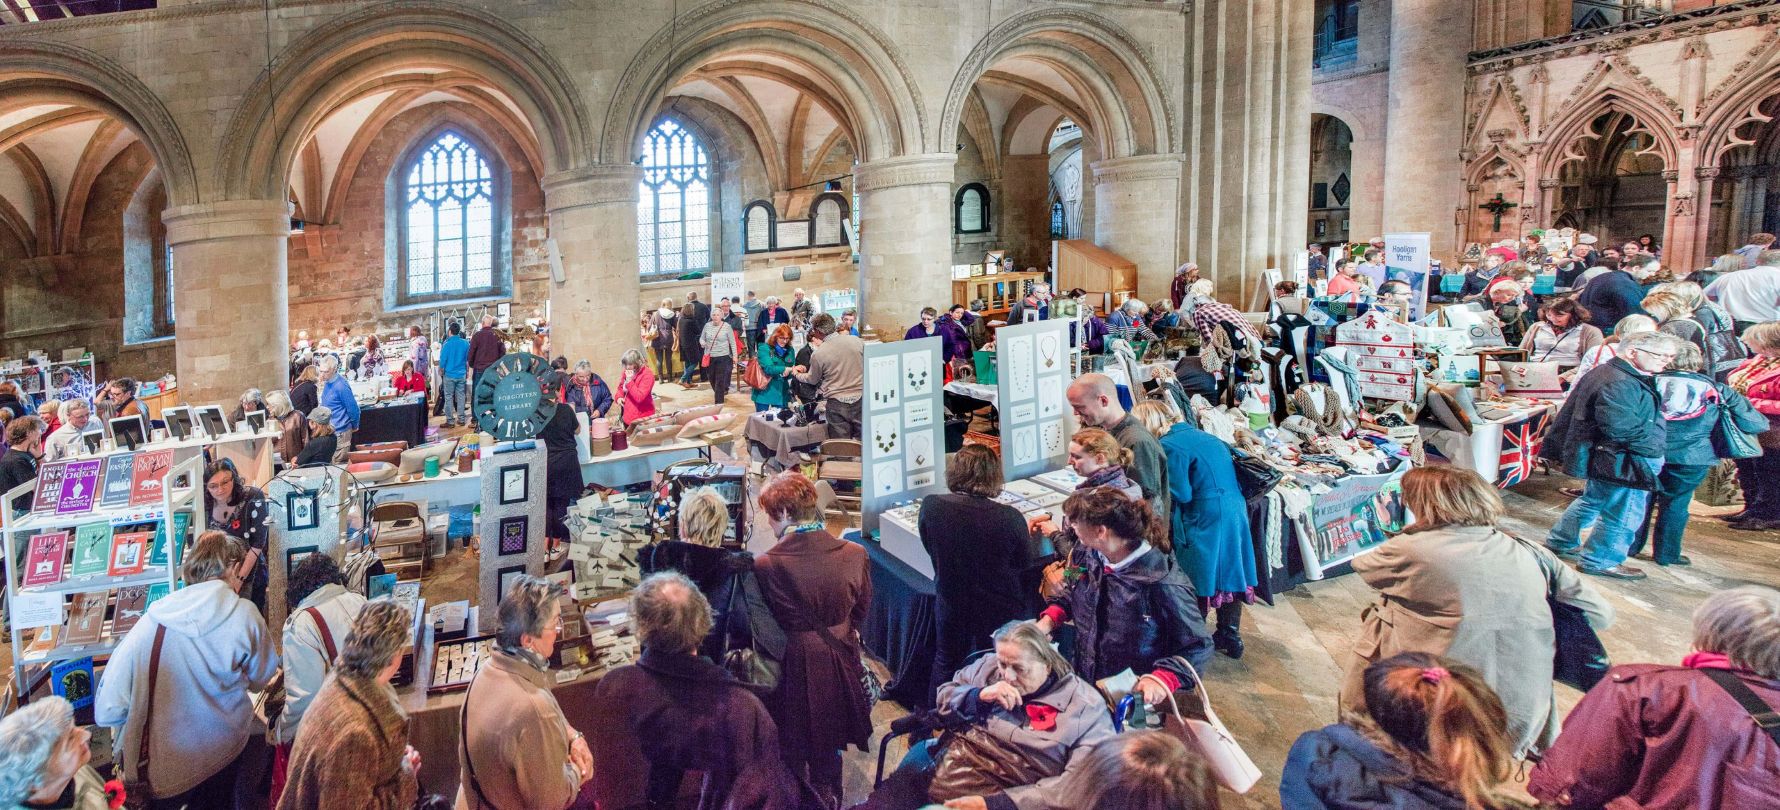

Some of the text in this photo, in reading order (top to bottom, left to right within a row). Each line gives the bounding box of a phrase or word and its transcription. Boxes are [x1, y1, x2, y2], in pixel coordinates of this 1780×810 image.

[1392, 245, 1417, 255] Hooligan
[1396, 254, 1413, 262] Yarns
[498, 391, 538, 401] FORGOTTEN
[504, 402, 533, 411] LIBRARY
[138, 453, 170, 465] ROMAN
[65, 470, 99, 480] CHURCH
[38, 536, 58, 547] LIFE
[55, 658, 92, 674] GRAHAM
